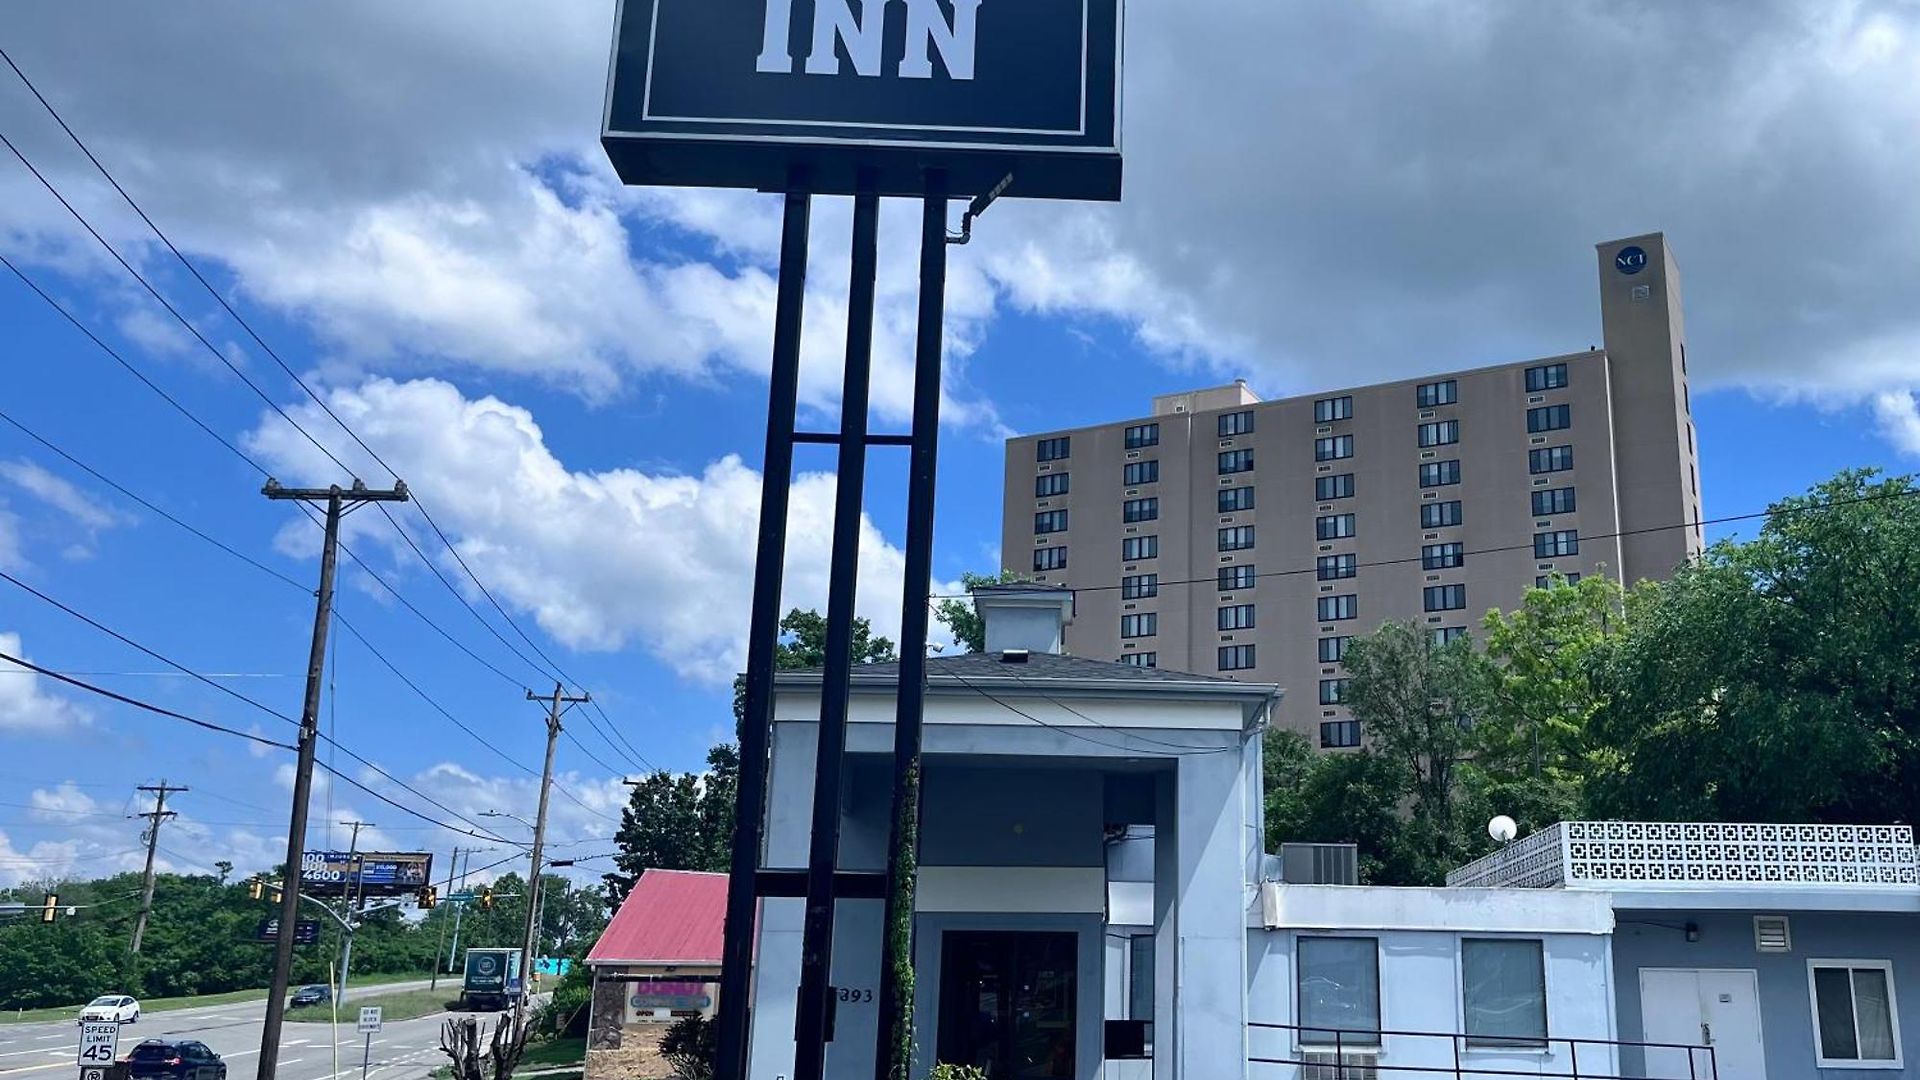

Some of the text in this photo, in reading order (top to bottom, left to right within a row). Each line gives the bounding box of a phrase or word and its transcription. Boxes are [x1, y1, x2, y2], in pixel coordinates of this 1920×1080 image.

[756, 0, 982, 80] INN
[302, 870, 340, 880] 4600
[83, 1045, 111, 1060] 45
